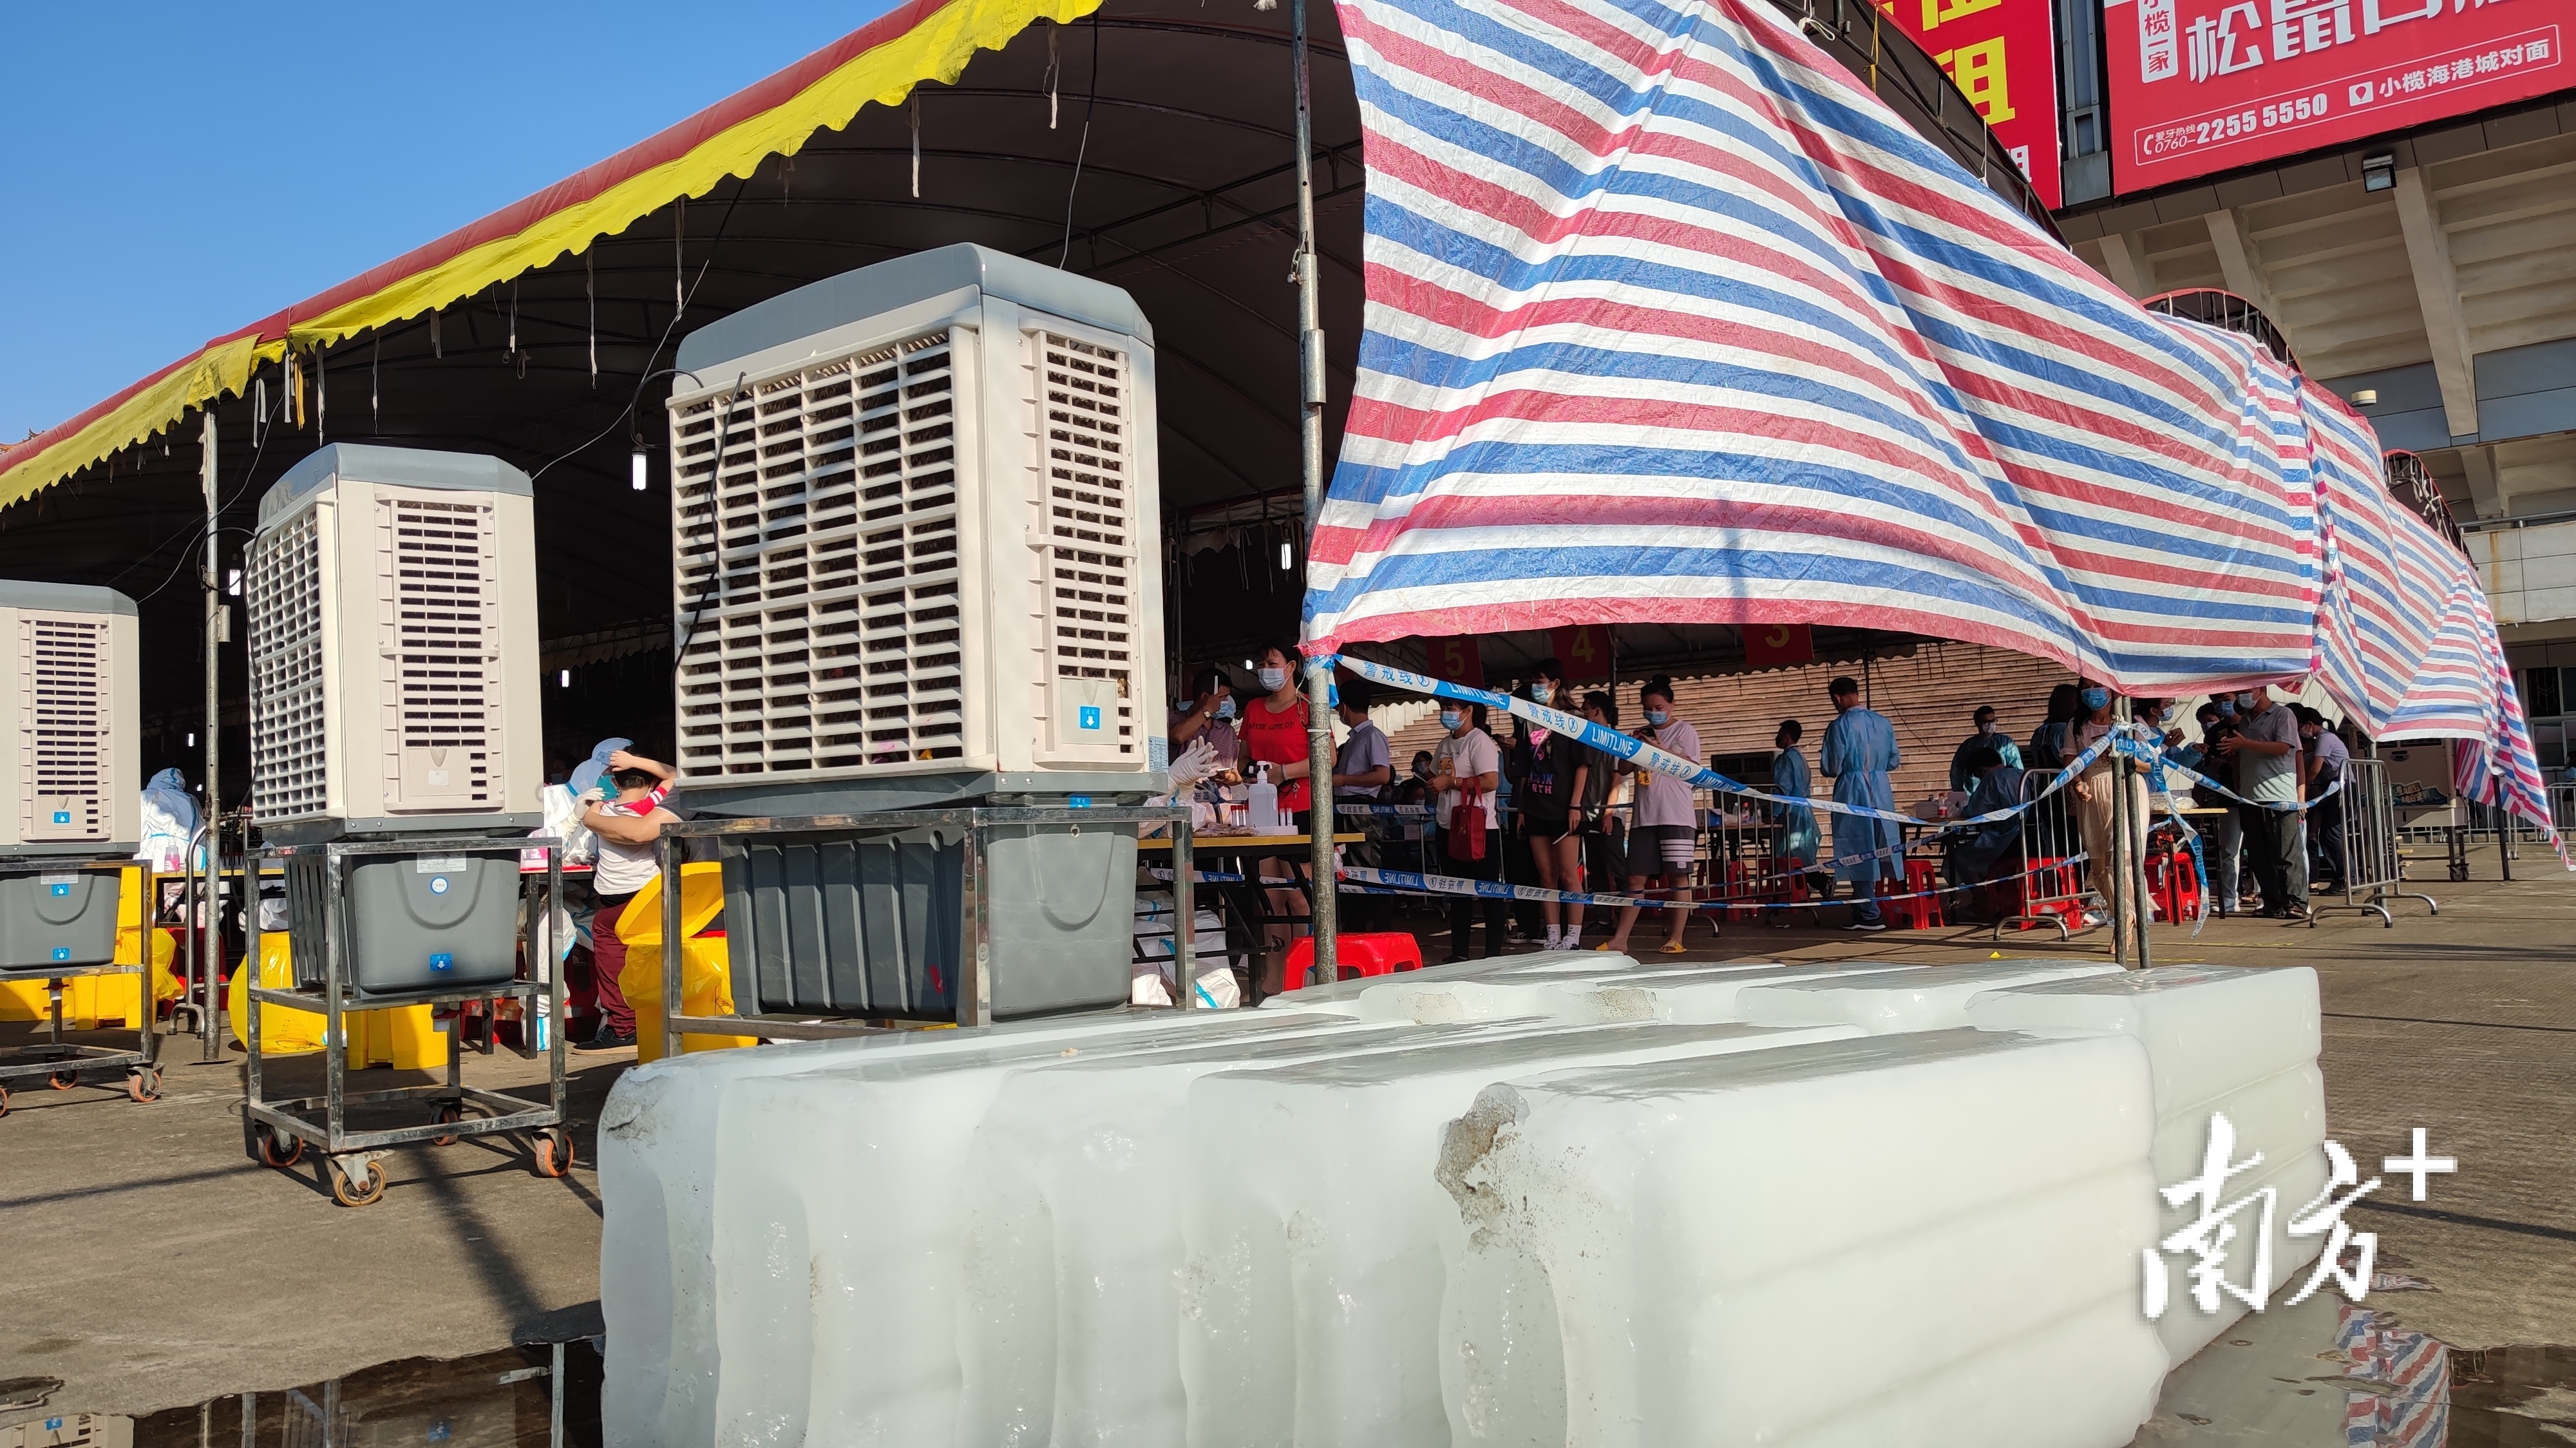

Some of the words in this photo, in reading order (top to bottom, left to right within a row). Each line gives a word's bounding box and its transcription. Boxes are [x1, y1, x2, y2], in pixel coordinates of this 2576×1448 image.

[2379, 39, 2550, 98] 小榄海港城对面
[2263, 93, 2327, 127] 5550
[2155, 124, 2195, 141] 爱牙热线
[1444, 640, 1465, 676] 5
[1571, 626, 1595, 663] 4
[1363, 661, 1414, 686] 警戒线
[1527, 703, 1566, 730] 警戒线
[1591, 726, 1634, 757] LIMITLINE
[1647, 751, 1681, 776] 警戒线
